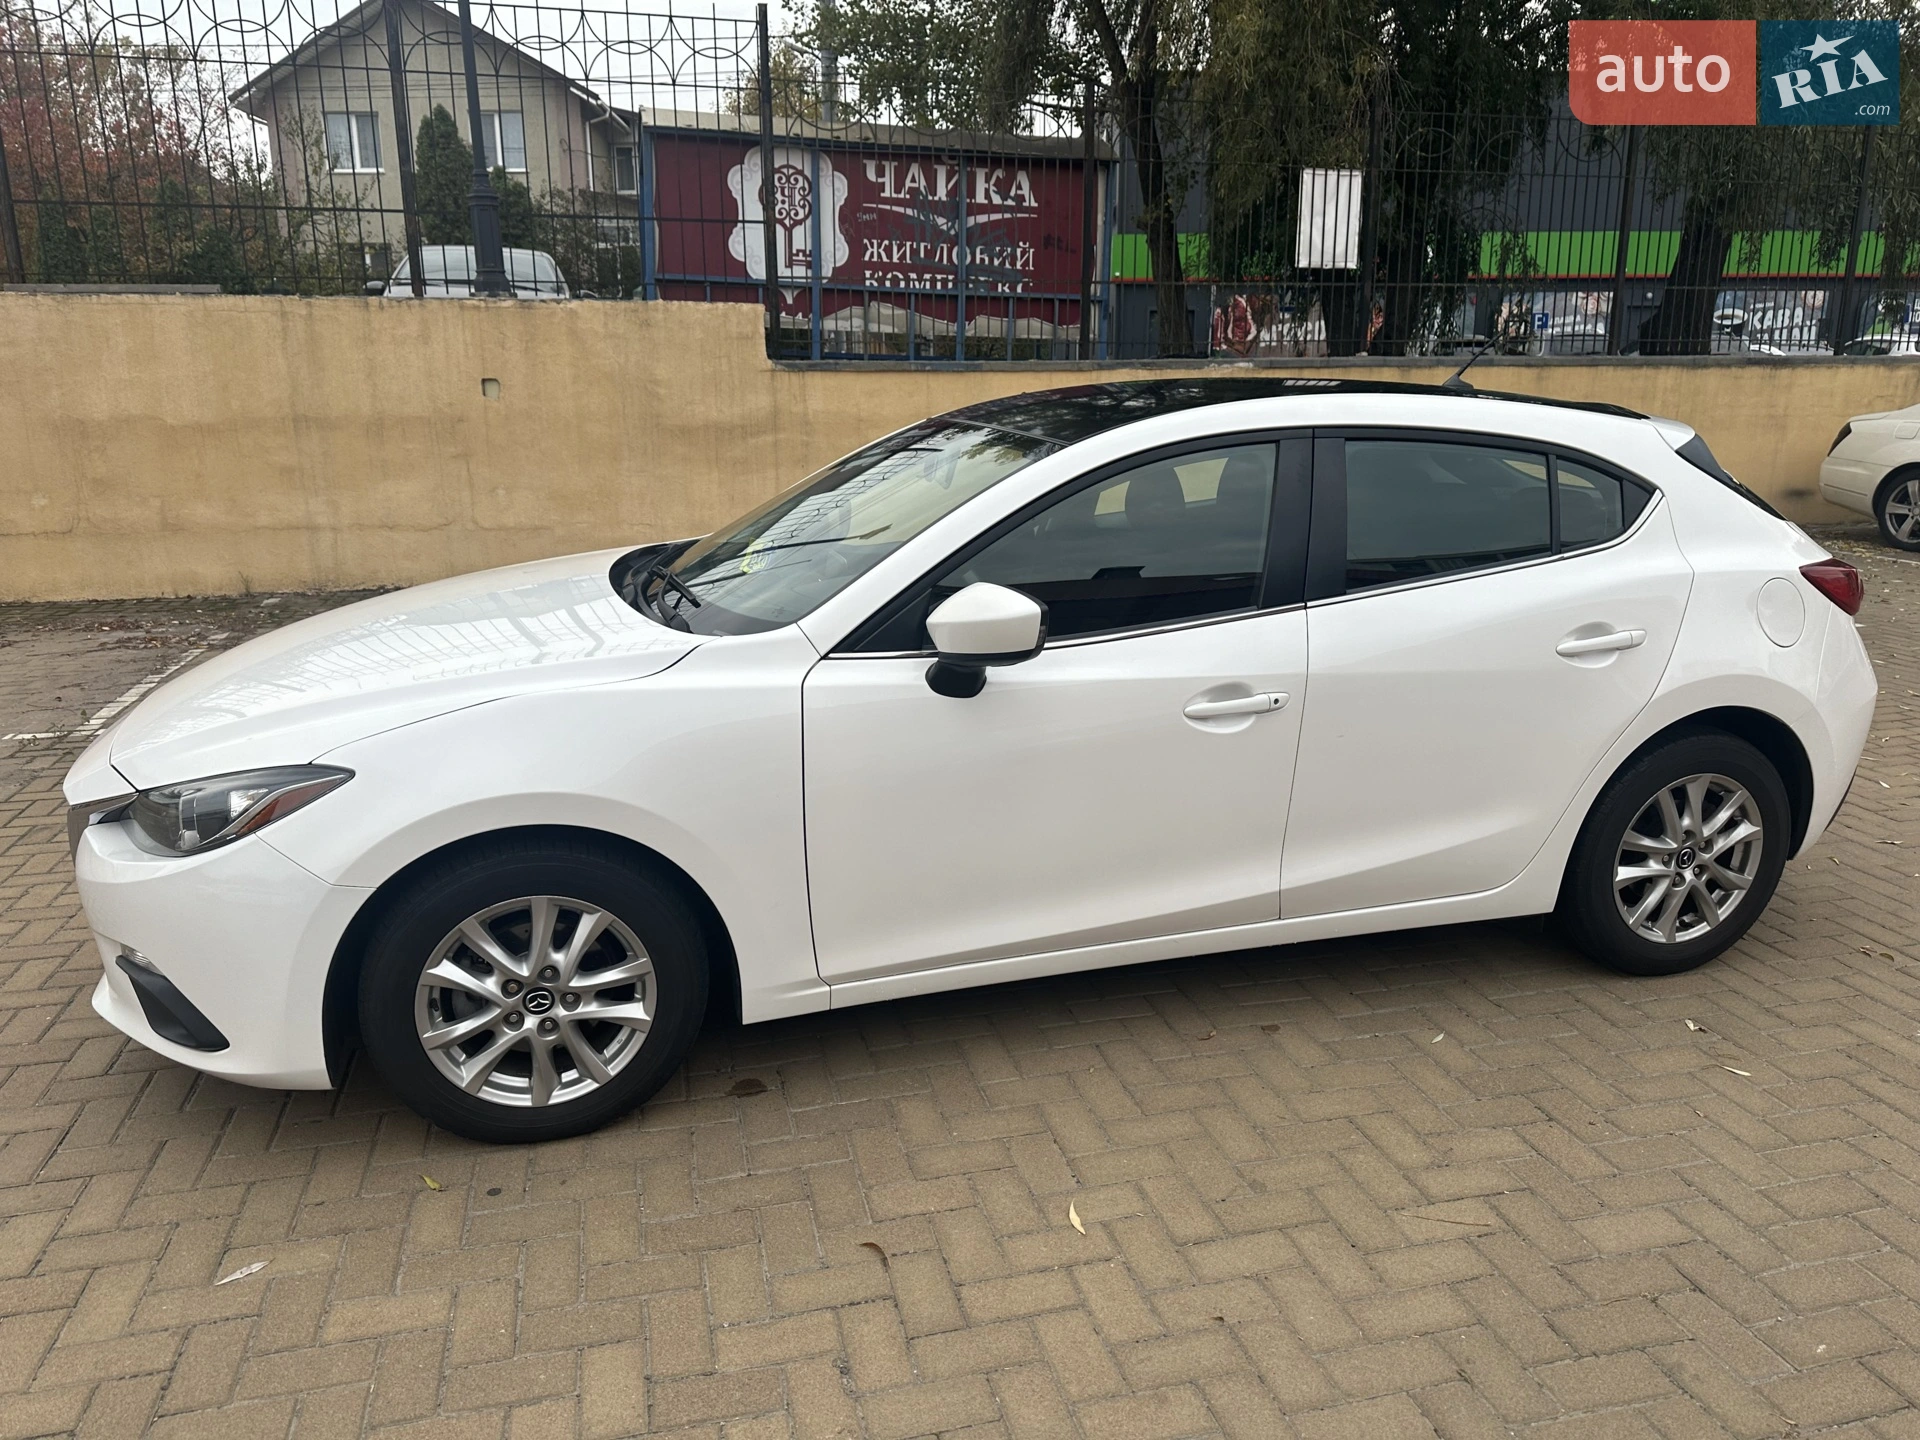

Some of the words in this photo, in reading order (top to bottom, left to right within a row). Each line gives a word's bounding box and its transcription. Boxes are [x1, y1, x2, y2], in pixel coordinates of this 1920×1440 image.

[862, 155, 1039, 207] ЧАЙКА
[862, 239, 1035, 271] ЖИТЛОВИЙ
[1748, 307, 1804, 332] КАВА
